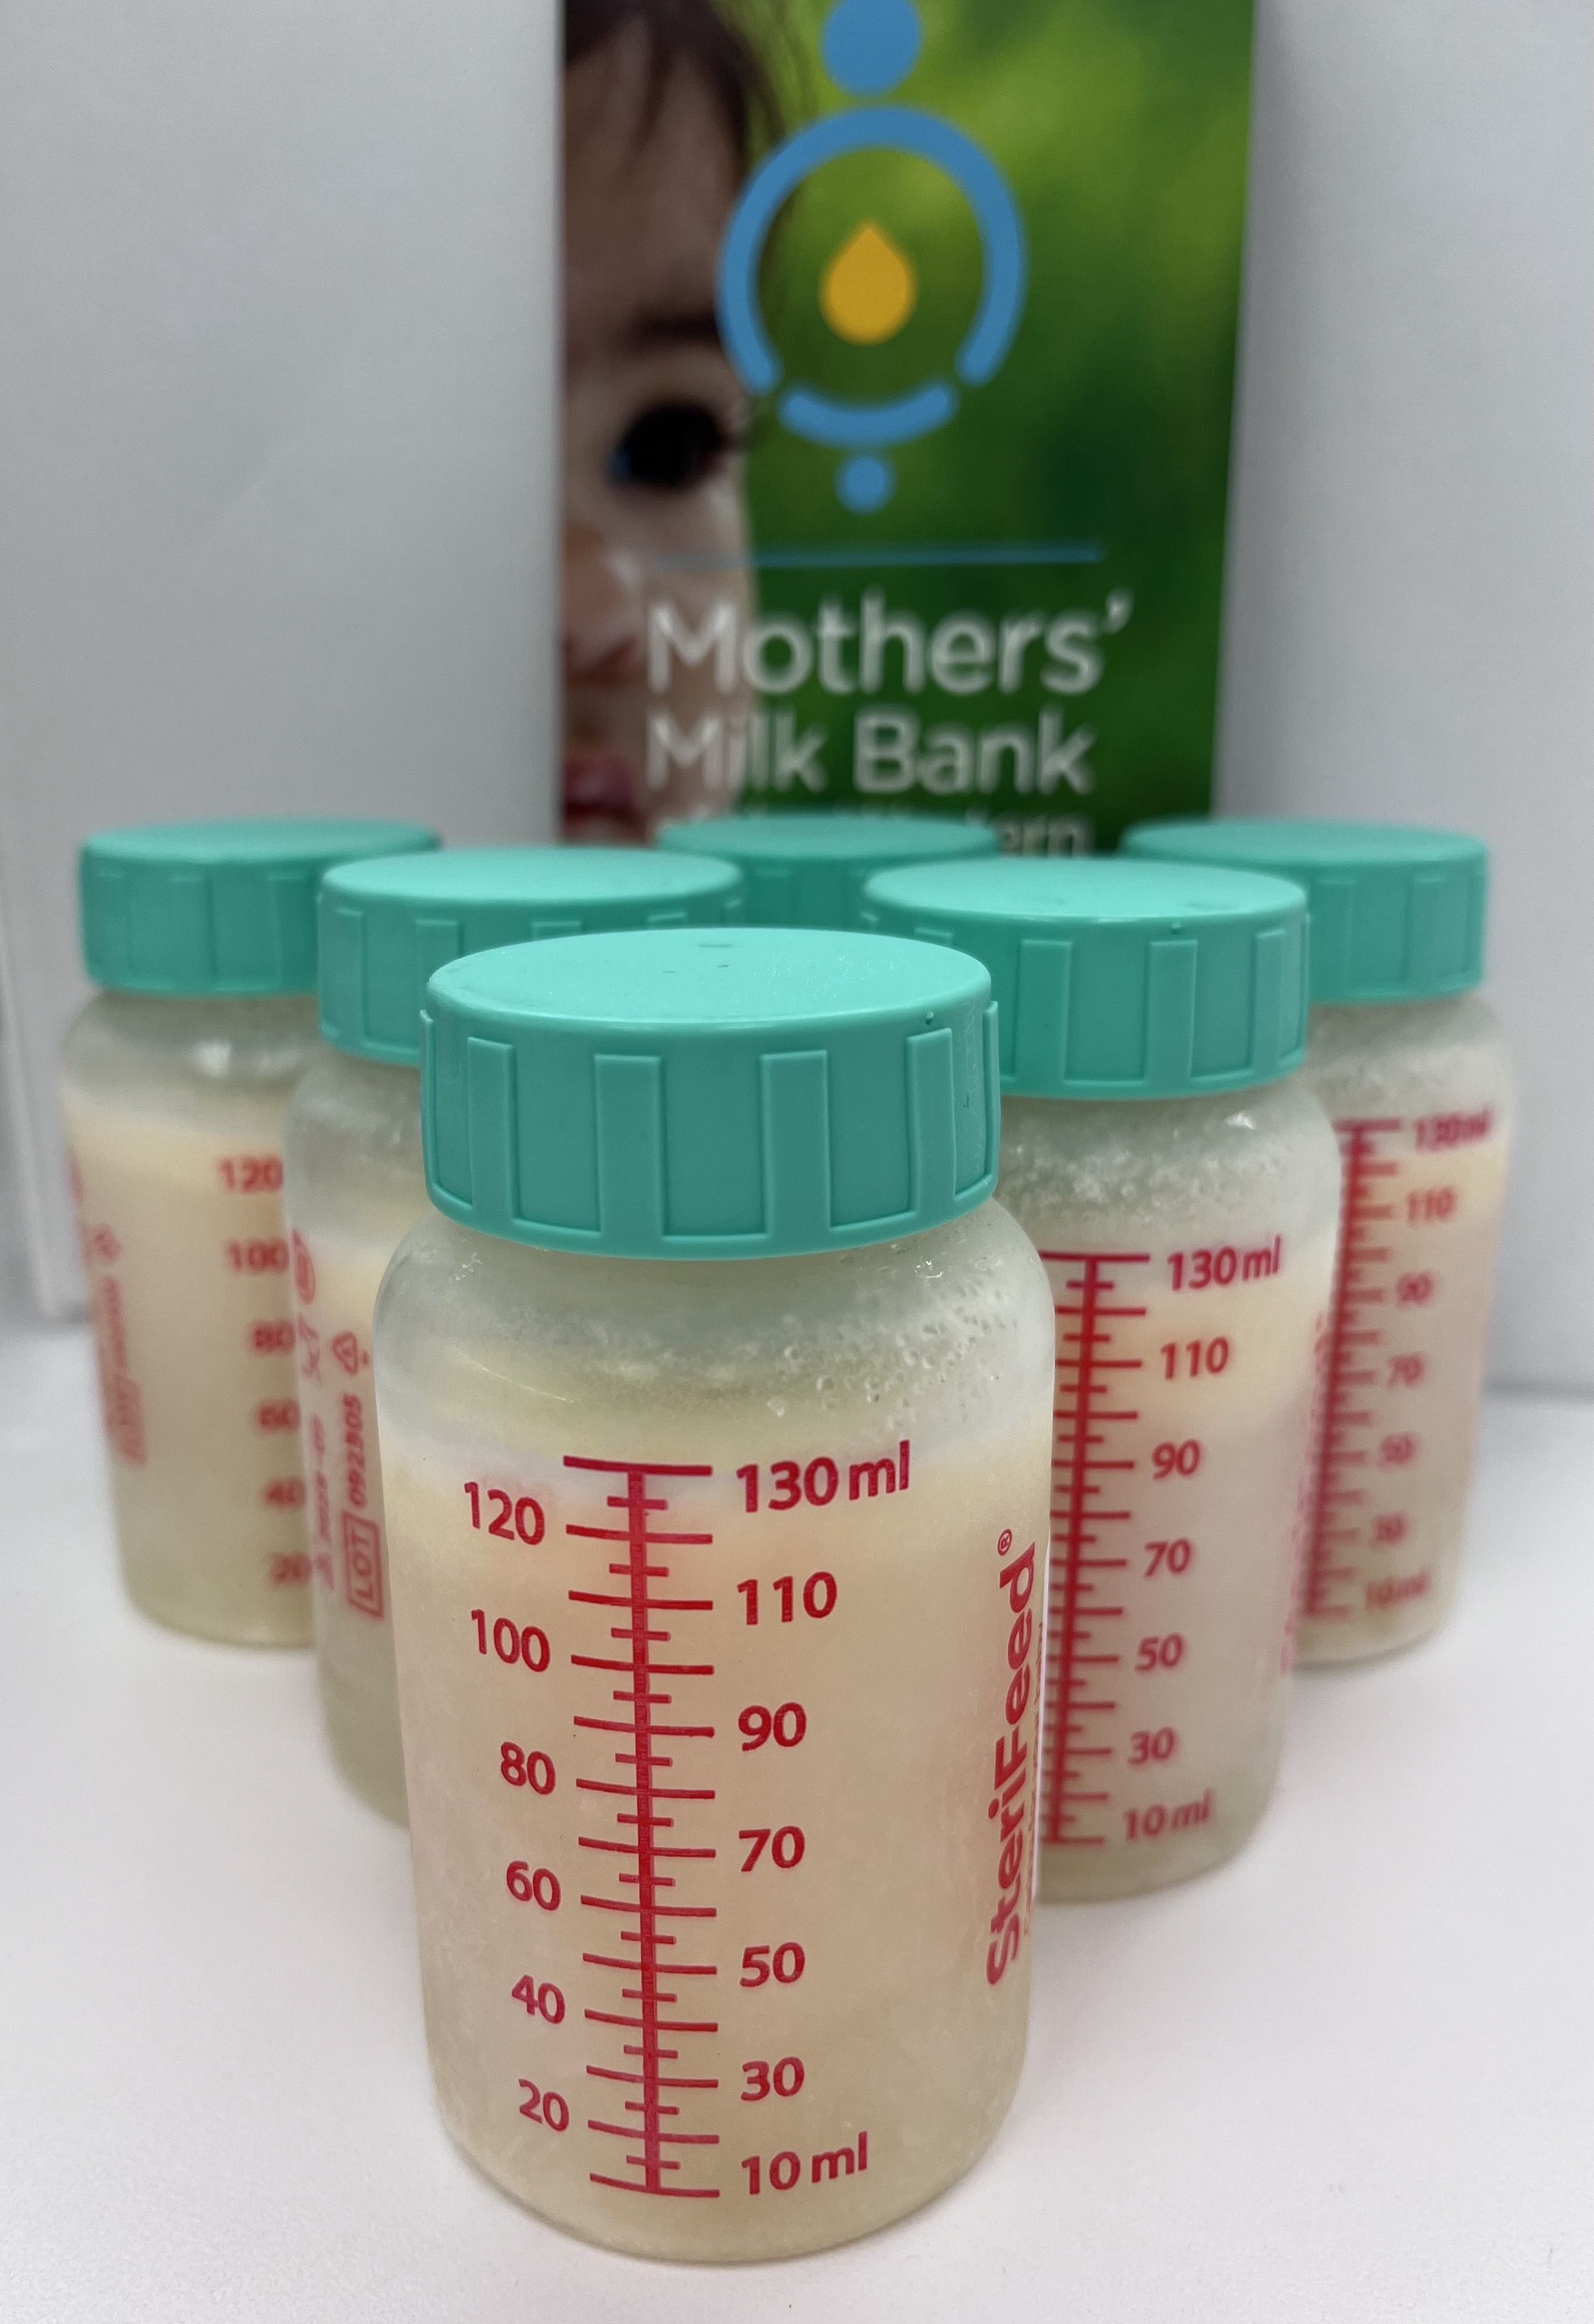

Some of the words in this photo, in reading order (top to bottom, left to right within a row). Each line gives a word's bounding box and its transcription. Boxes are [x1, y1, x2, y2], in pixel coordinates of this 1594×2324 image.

[645, 708, 827, 792] Milk
[854, 708, 1095, 795] Bank
[219, 1156, 283, 1193] 120
[1405, 1187, 1456, 1224] 110
[227, 1240, 289, 1273] 100
[1162, 1337, 1231, 1380] 110
[737, 1457, 839, 1514] 130
[848, 1440, 911, 1502] ml
[1153, 1440, 1202, 1479] 90
[464, 1482, 545, 1546] 120
[1145, 1539, 1193, 1577] 70
[738, 1571, 838, 1626] 110
[471, 1609, 550, 1673] 100
[1136, 1634, 1185, 1672] 50
[738, 1703, 807, 1752] 90
[1131, 1729, 1177, 1766] 30
[500, 1742, 557, 1796] 80
[739, 1826, 806, 1873] 70
[506, 1861, 561, 1912] 60
[740, 1942, 806, 1989] 50
[511, 1976, 566, 2024] 40
[741, 2057, 805, 2102] 30
[519, 2079, 570, 2133] 20
[742, 2151, 801, 2195] 10
[812, 2131, 869, 2184] ml
